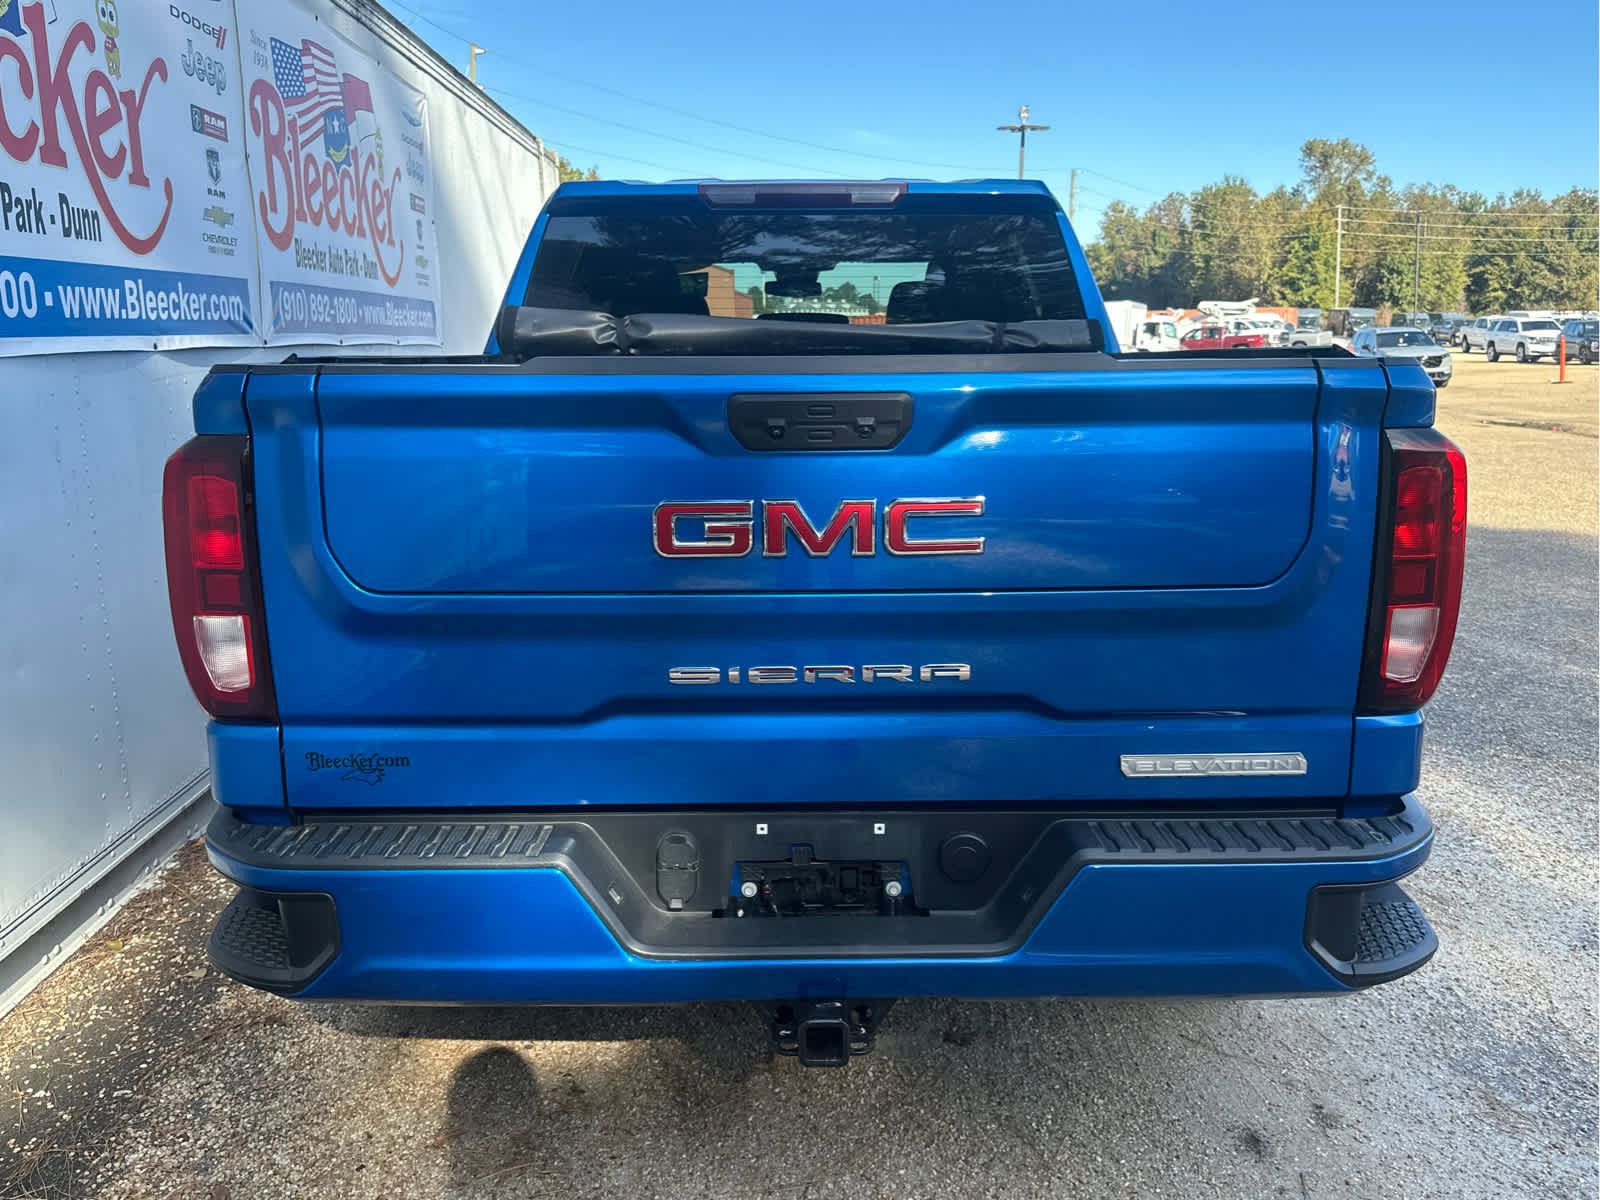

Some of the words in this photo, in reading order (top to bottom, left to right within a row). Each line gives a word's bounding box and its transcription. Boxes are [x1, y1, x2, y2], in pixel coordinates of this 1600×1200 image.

[170, 4, 221, 40] DODGE
[181, 38, 227, 96] Jeep
[204, 113, 225, 129] RAM
[0, 181, 47, 235] Park
[58, 192, 102, 242] Dunn
[207, 187, 226, 200] RAM
[202, 232, 238, 247] CHEVROLET
[294, 237, 327, 273] Bleecker
[328, 243, 344, 275] Auto
[344, 248, 360, 277] Park
[363, 251, 379, 281] Dunn
[57, 279, 244, 321] www.Bleecker.com
[279, 287, 308, 328] (910)
[310, 293, 358, 324] 892-1800
[364, 301, 433, 328] www.Bleecker.com
[653, 495, 986, 558] GMC
[668, 663, 972, 686] SIERRA
[1135, 758, 1293, 772] ELEVATION
